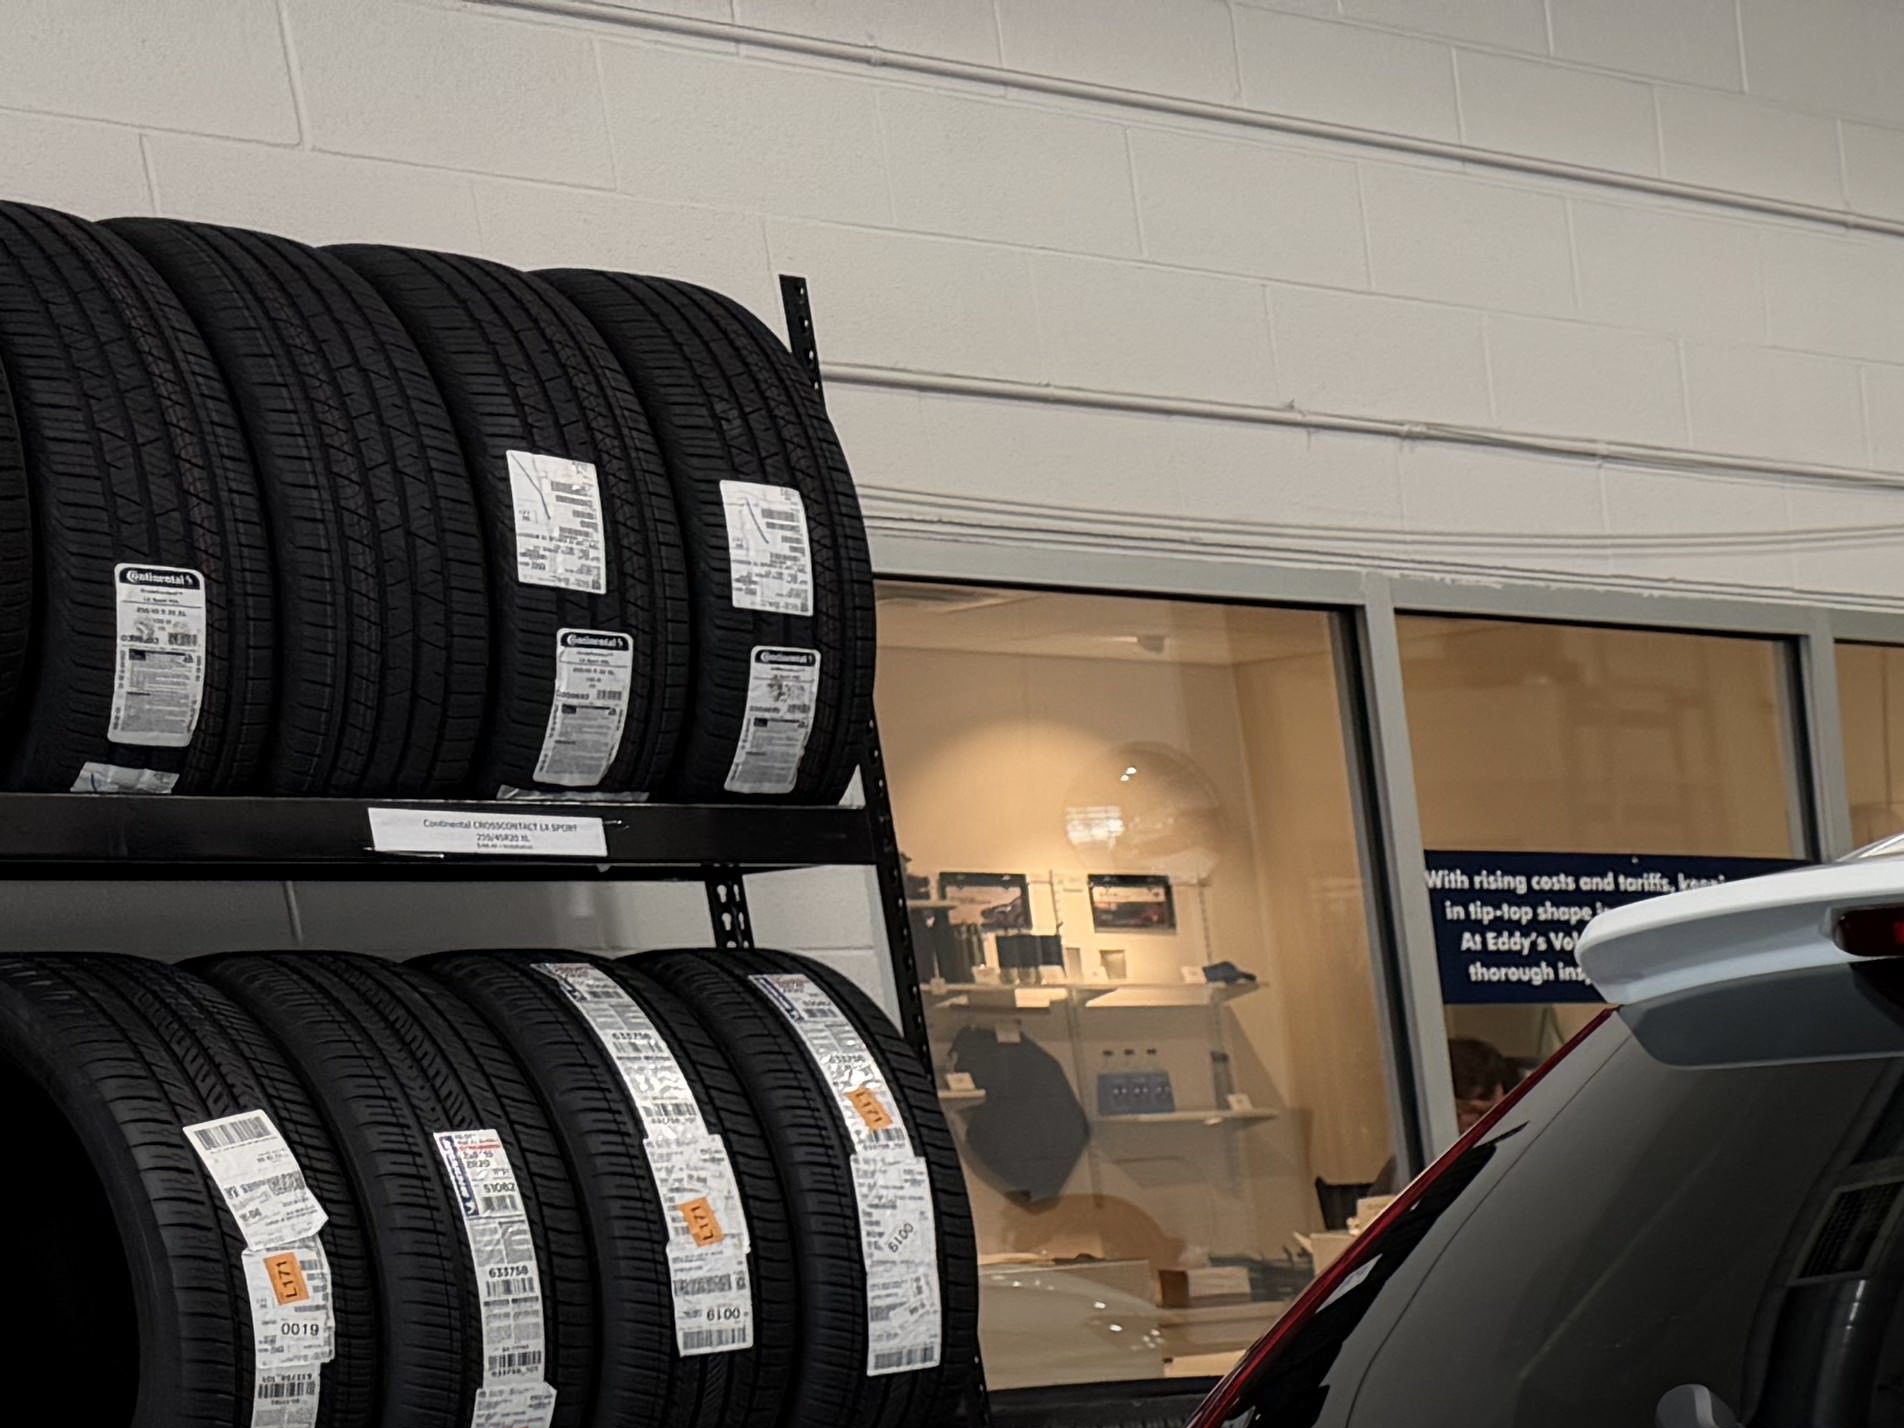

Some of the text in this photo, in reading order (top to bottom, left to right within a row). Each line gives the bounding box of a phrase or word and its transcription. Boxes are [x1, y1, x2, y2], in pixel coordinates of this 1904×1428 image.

[1425, 868, 1470, 891] With
[1473, 869, 1527, 894] rising
[1531, 872, 1576, 892] costs
[1579, 873, 1615, 892] and
[1618, 873, 1676, 894] tariffs,
[1445, 901, 1465, 920] in
[1469, 902, 1533, 925] tip-top
[1536, 903, 1593, 926] shape
[1461, 933, 1482, 951] At
[1486, 933, 1547, 956] Eddy's
[1469, 962, 1555, 986] thorough
[276, 1261, 297, 1298] L171
